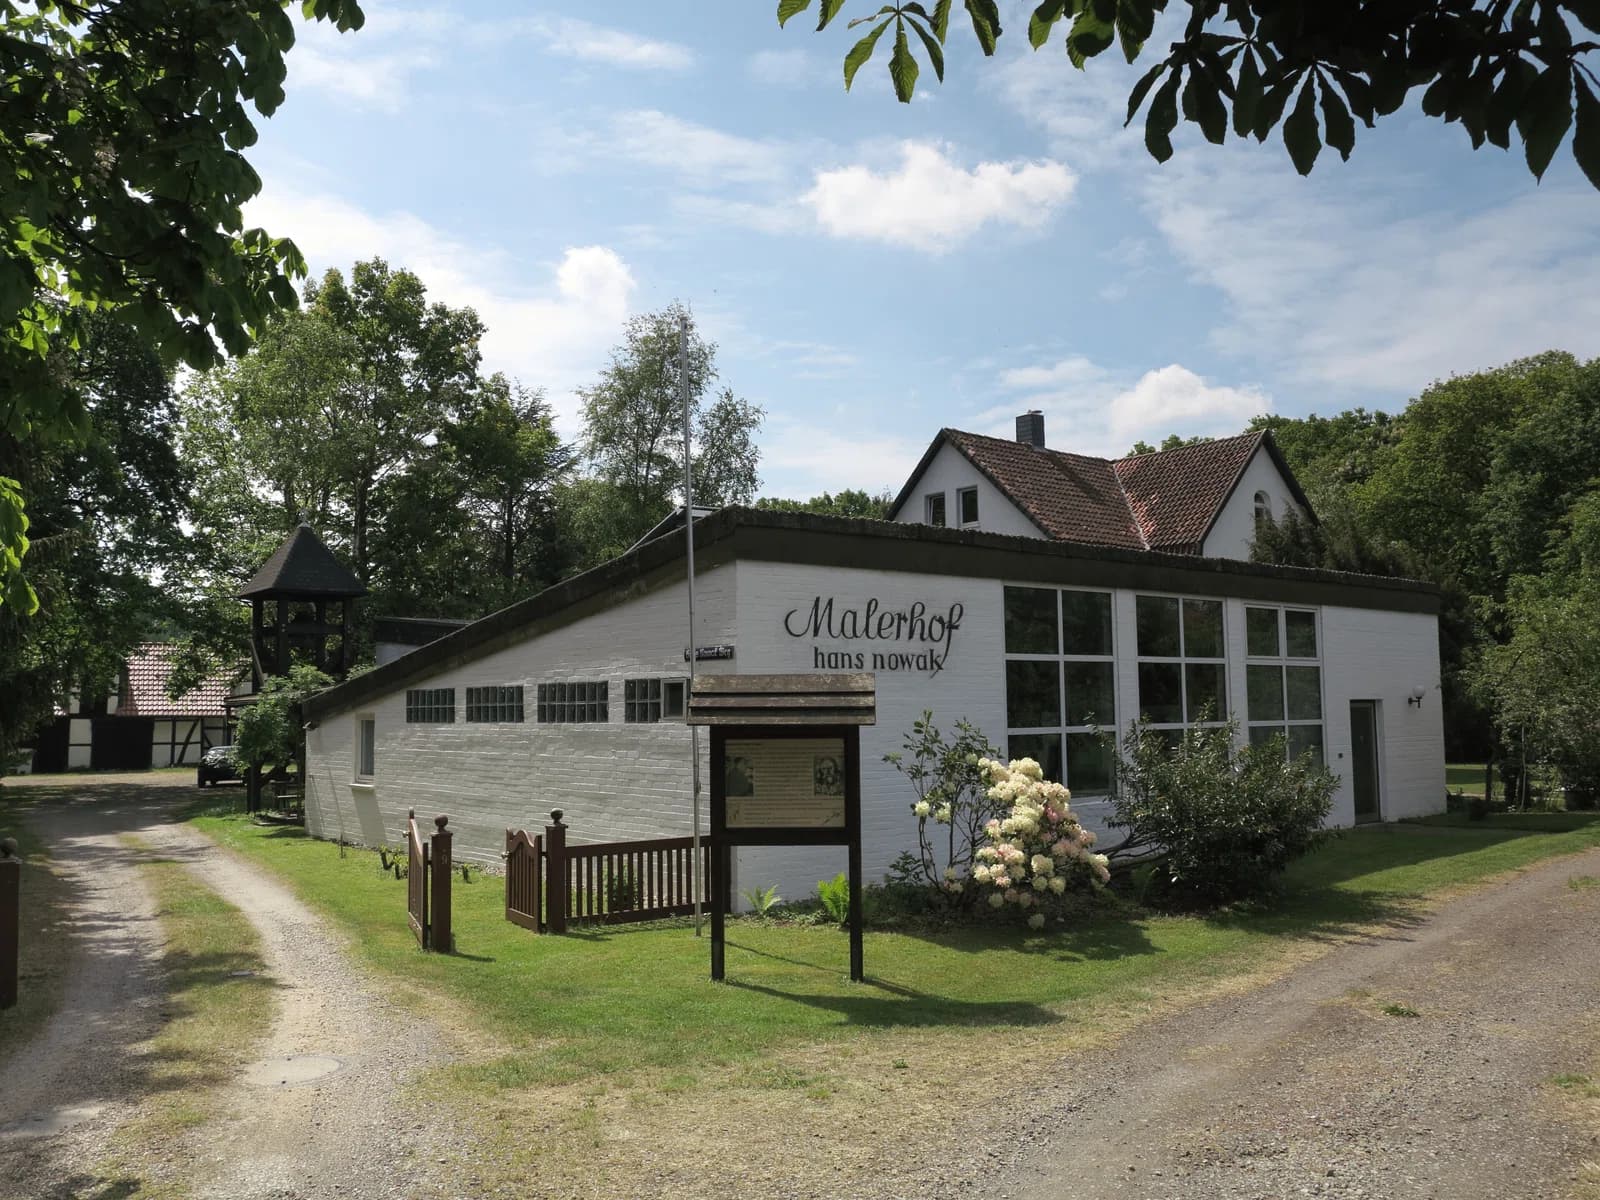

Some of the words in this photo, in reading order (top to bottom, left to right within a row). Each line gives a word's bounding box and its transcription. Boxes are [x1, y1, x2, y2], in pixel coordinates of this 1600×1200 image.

[784, 596, 964, 679] Malerhof
[813, 646, 865, 669] hans
[872, 648, 944, 671] nowak
